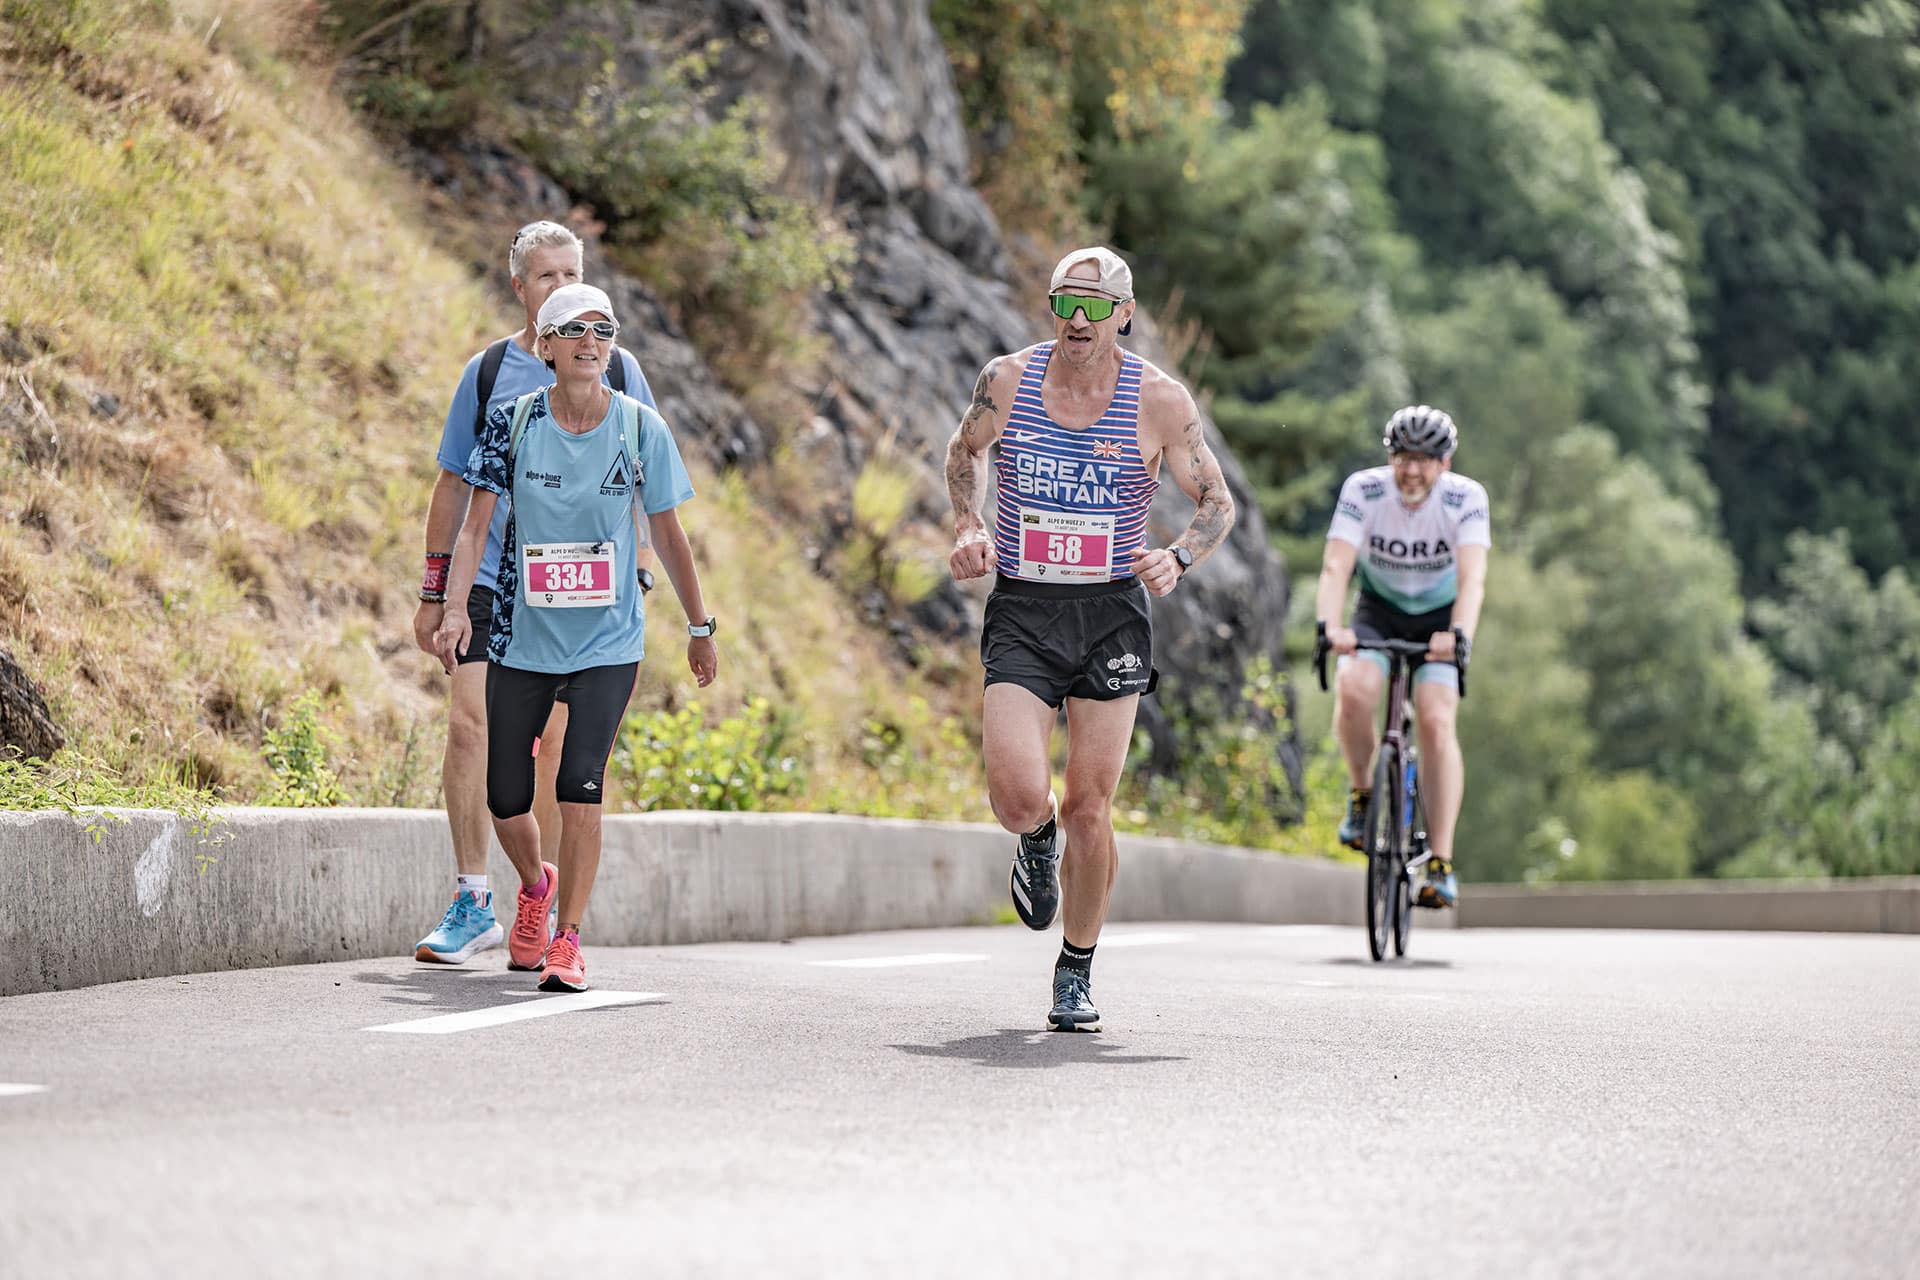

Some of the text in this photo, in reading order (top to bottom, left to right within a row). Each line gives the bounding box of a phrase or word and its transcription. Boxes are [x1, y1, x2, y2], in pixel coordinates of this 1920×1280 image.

[1016, 452, 1120, 485] GREAT
[1017, 473, 1119, 505] BRITAIN
[1047, 517, 1060, 525] ALPE
[1060, 518, 1079, 526] D'HUEZ
[1047, 534, 1083, 564] 58
[1370, 535, 1450, 558] BORA
[545, 563, 594, 591] 334
